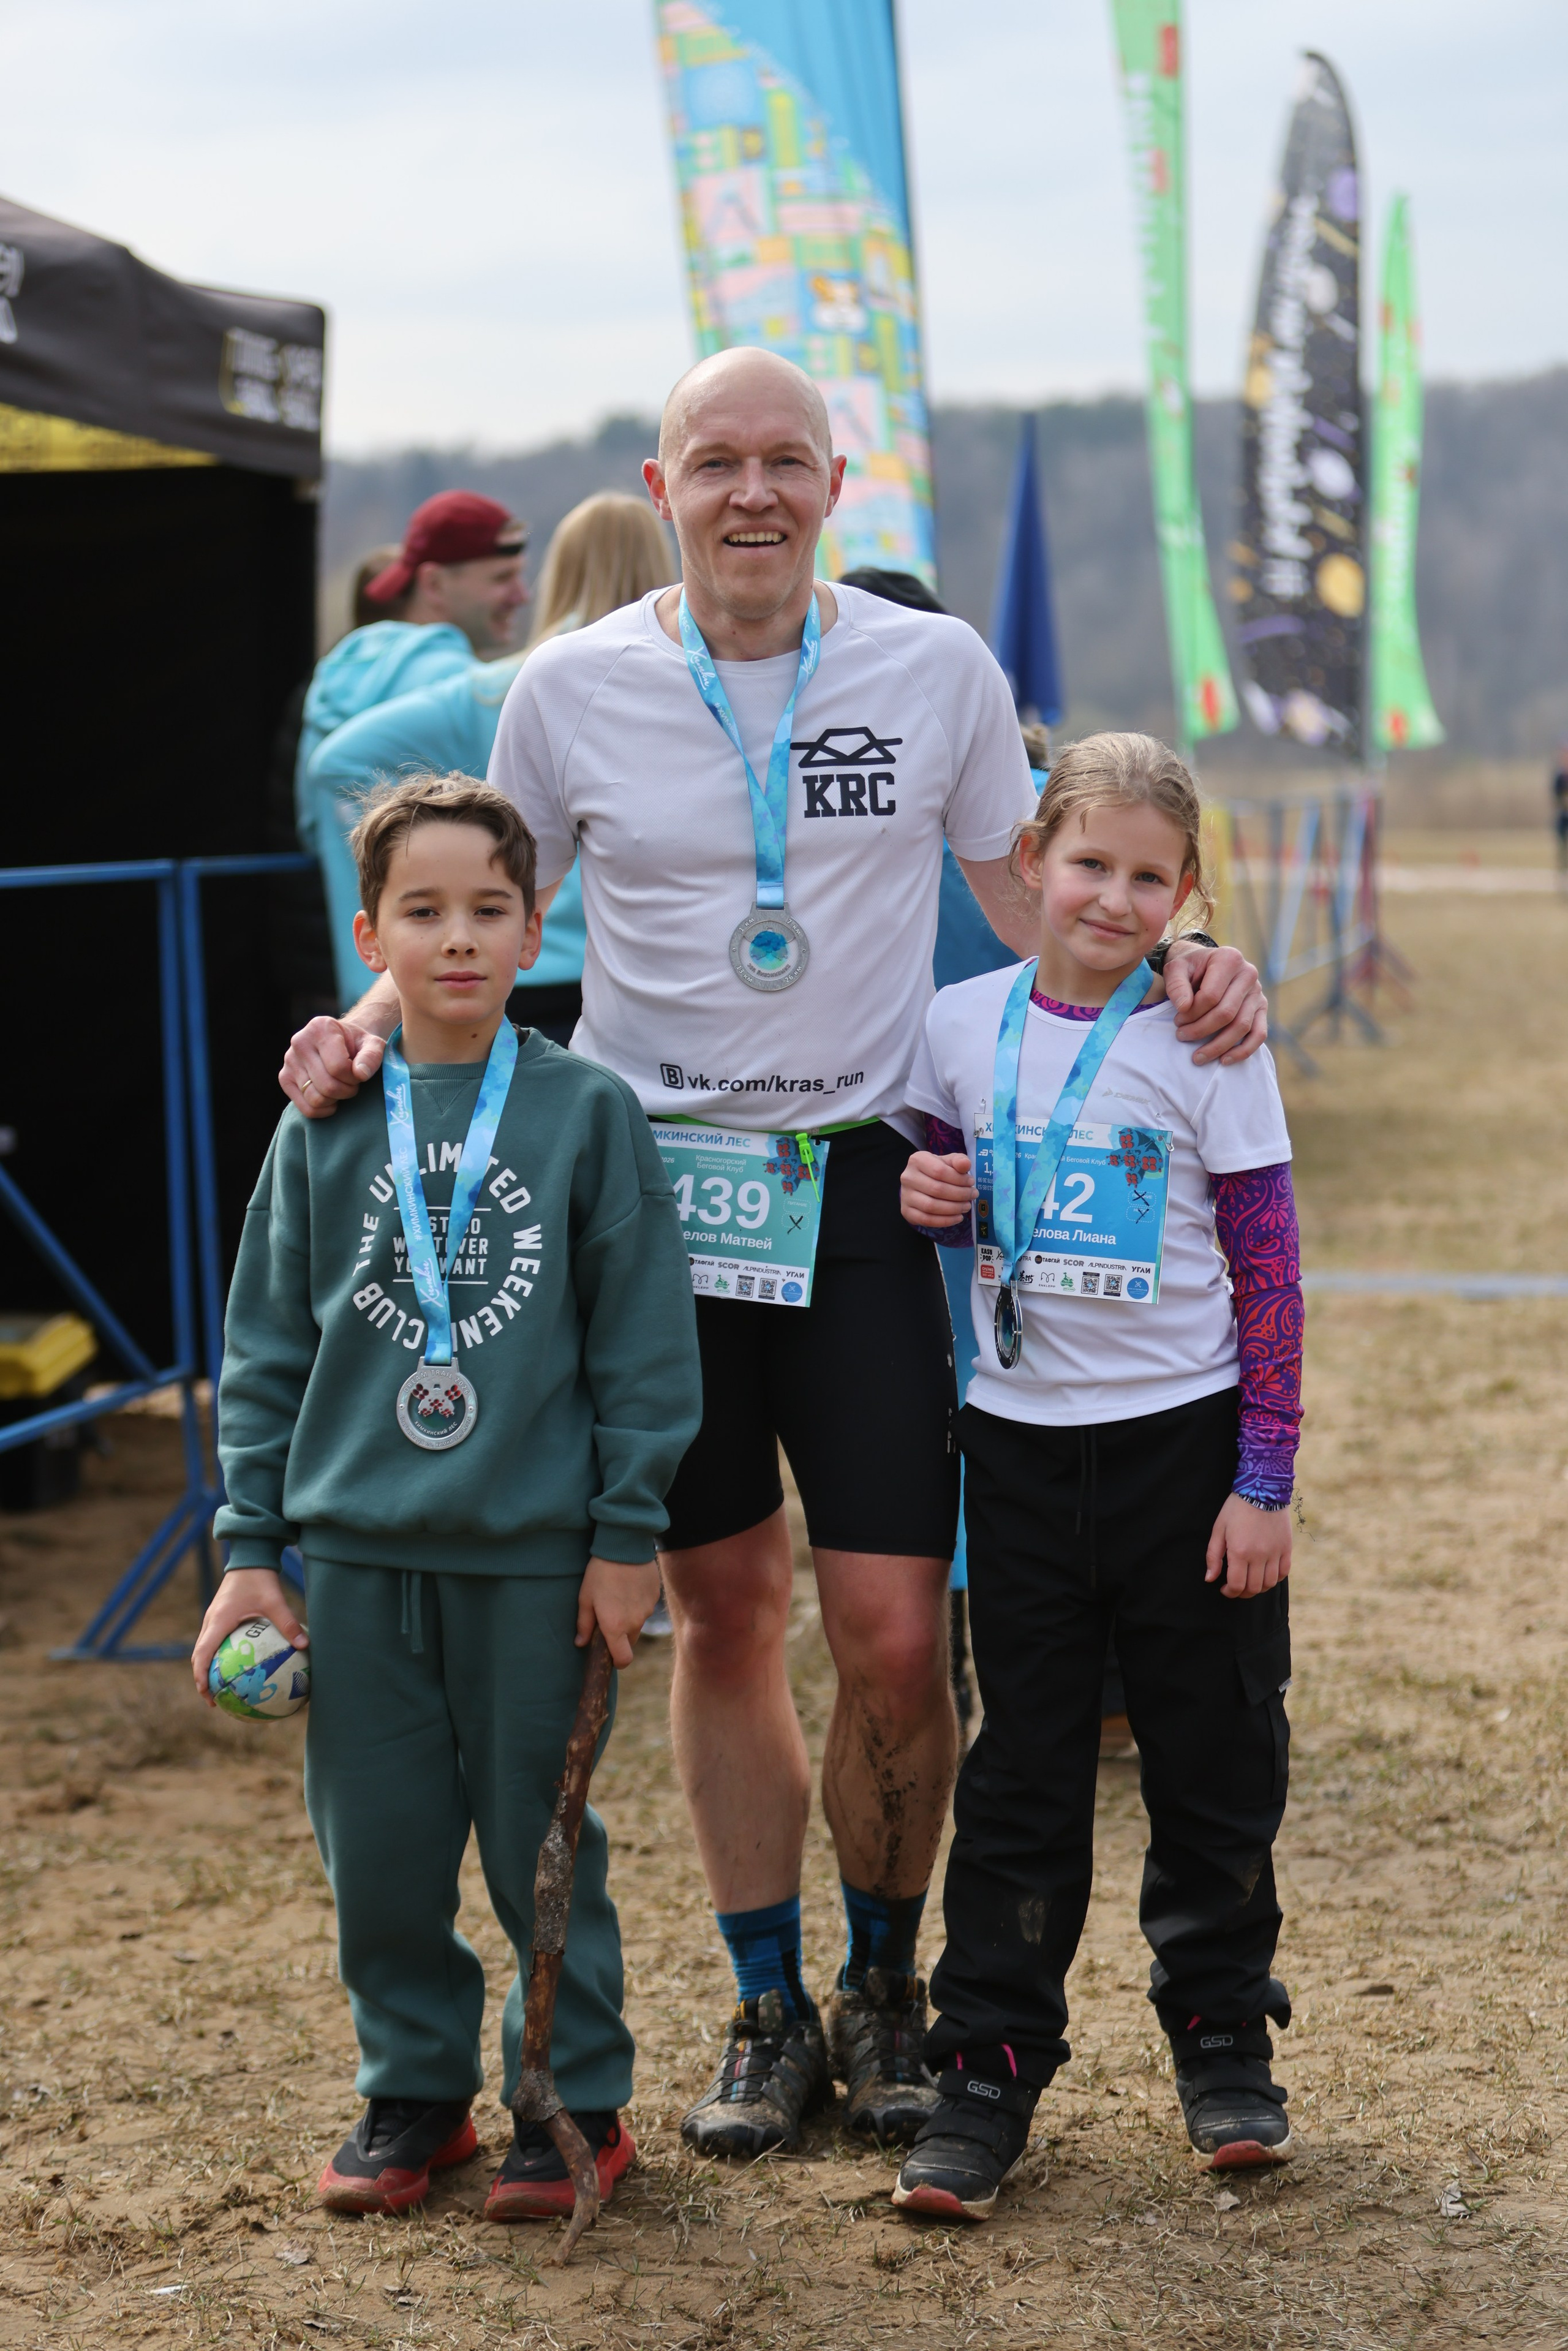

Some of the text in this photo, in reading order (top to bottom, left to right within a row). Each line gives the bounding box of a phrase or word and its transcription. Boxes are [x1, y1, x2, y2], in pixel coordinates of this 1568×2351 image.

[802, 772, 896, 818] KRC
[736, 965, 744, 974] 13
[784, 974, 793, 983] 26
[687, 1071, 864, 1095] vk.com/kras_run
[653, 1130, 751, 1148] МКИНСКИЙ ЛЕС
[695, 1155, 747, 1166] Красногорский
[696, 1161, 744, 1174] Беговой Клуб
[400, 1169, 423, 1242] #ХИМКИНСКИЙ
[673, 1173, 771, 1229] 439
[352, 1212, 380, 1277] THE
[682, 1231, 772, 1250] елов Матвей
[1032, 1228, 1117, 1245] елова Лиана
[718, 1261, 739, 1270] SCOR
[742, 1266, 781, 1275] ALPINDUSTRIA
[1088, 1262, 1127, 1271] ALPINDUSTRIA
[353, 1282, 425, 1349] CLUB
[404, 1370, 470, 1395] DREAM TRAIL 2026
[414, 1421, 458, 1436] ХИМКИНСКИЙ ЛЕС
[1200, 2034, 1234, 2048] GSD
[967, 2080, 1001, 2099] GSD
